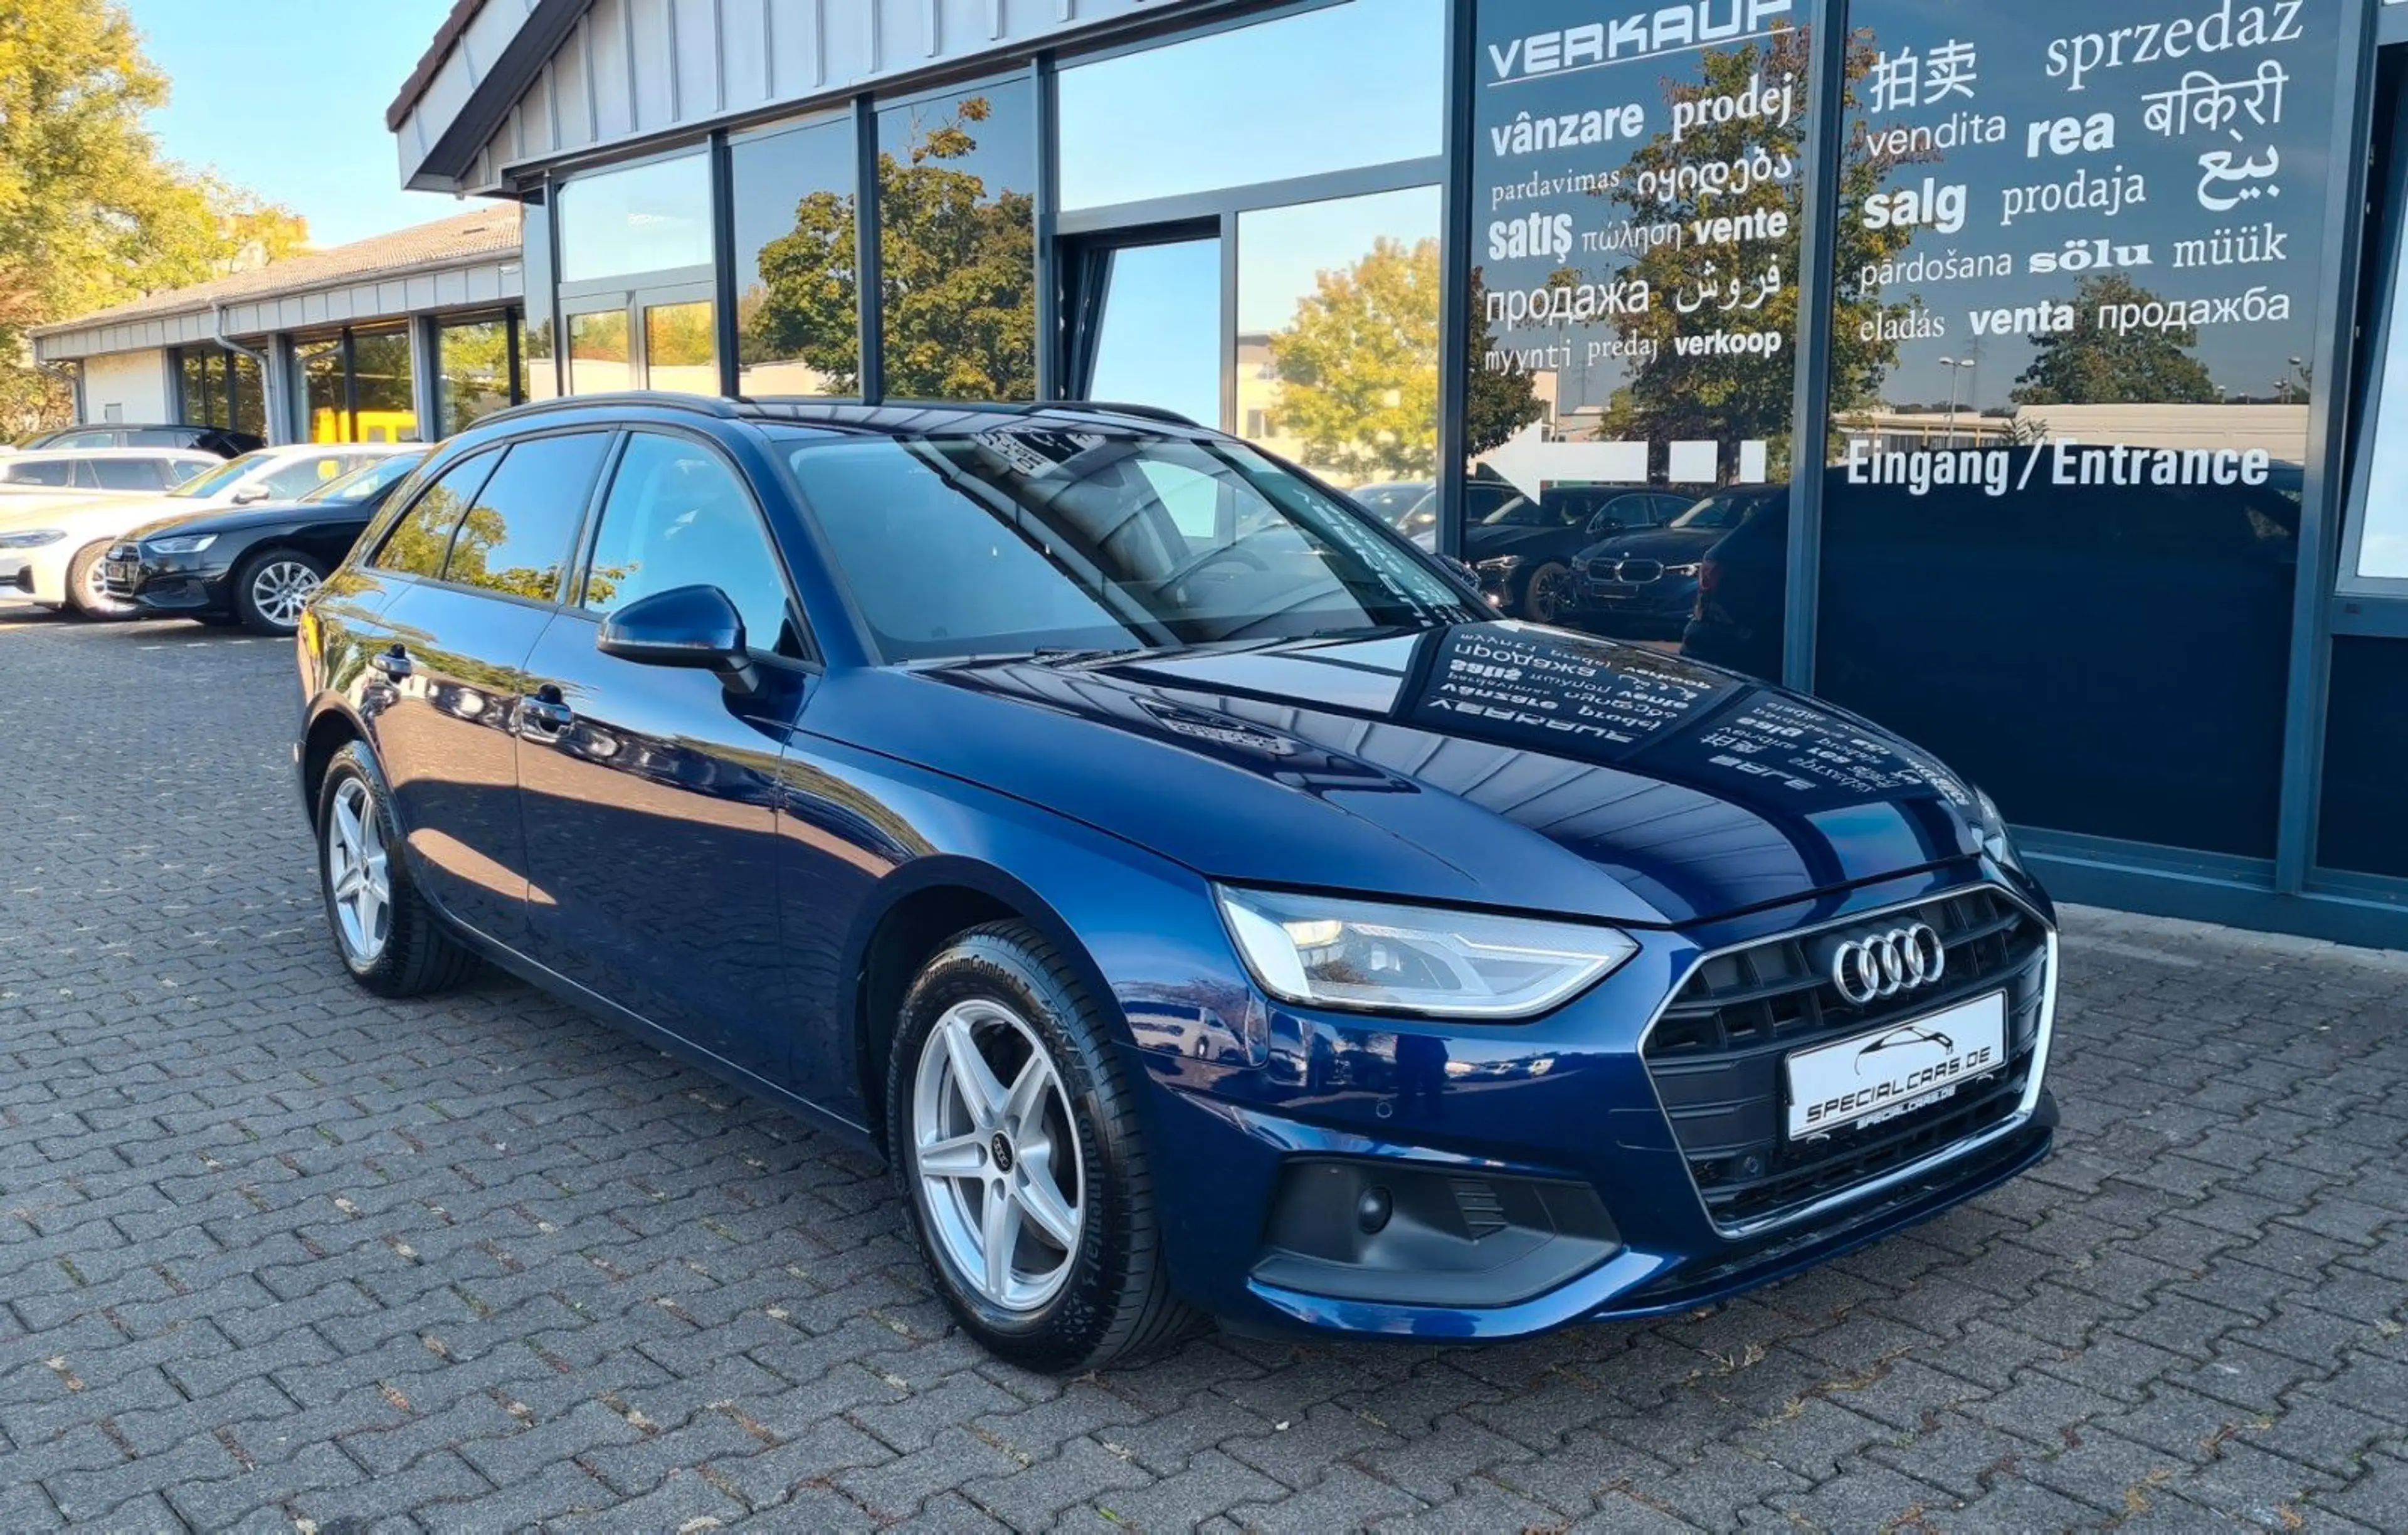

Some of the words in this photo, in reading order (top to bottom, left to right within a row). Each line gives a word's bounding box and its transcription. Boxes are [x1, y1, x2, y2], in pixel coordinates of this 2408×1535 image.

[1870, 38, 1977, 113] 拍卖
[1491, 103, 1644, 156] vânzare
[1671, 73, 1793, 143] prodej
[1866, 112, 2005, 157] vendita
[2027, 113, 2114, 157] rea
[1492, 169, 1619, 210] pardavimas
[1862, 177, 1967, 234] salg
[2000, 165, 2146, 226] prodaja
[2197, 144, 2280, 211] بيع
[1489, 211, 1573, 263] satış
[1582, 221, 1681, 253] πώληση
[1694, 208, 1788, 245] vente
[1861, 250, 2012, 295] pārdošana
[2029, 239, 2153, 274] sölu
[2173, 222, 2288, 268] müük
[1487, 278, 1649, 330] продажа
[1861, 309, 1945, 342] eladás
[1969, 299, 2075, 336] venta
[2098, 286, 2289, 337] продажба
[1485, 339, 1571, 376] myynti
[1588, 329, 1658, 364] predaj
[1674, 330, 1781, 358] verkoop
[1848, 438, 2007, 496] Eingang
[2052, 438, 2269, 486] Entrance
[1806, 1046, 1992, 1124] SPECIALCARS.DE
